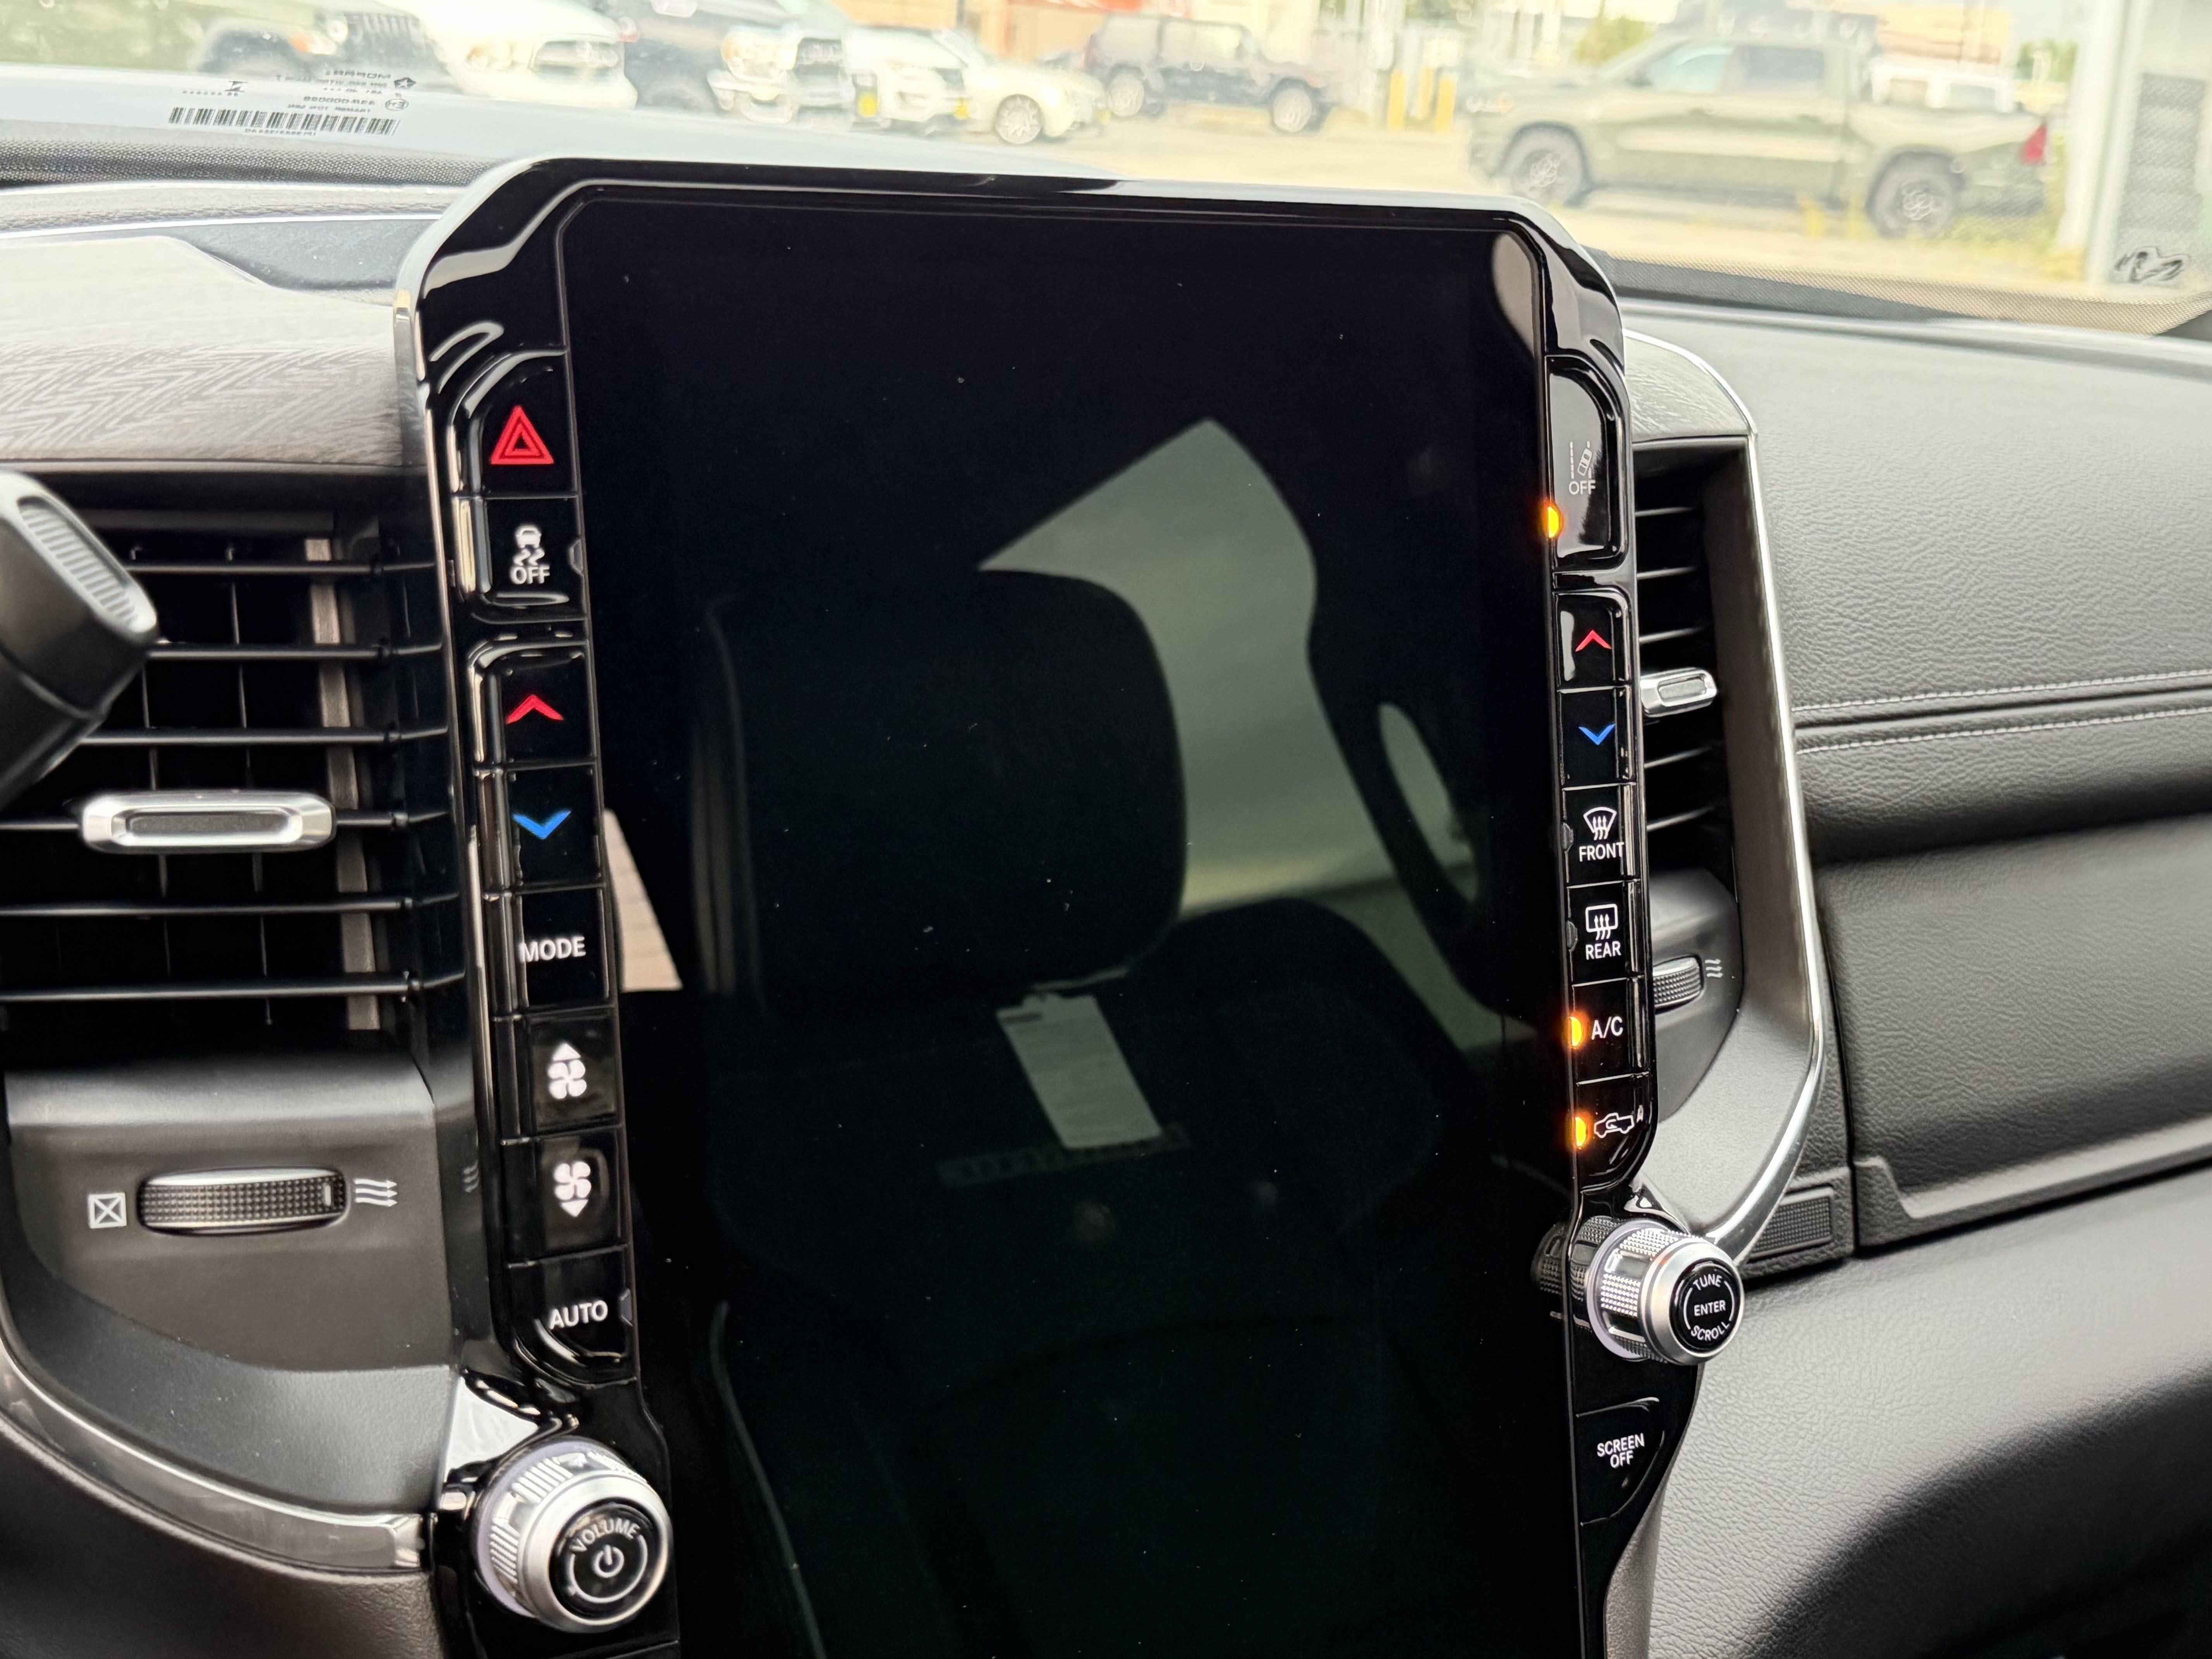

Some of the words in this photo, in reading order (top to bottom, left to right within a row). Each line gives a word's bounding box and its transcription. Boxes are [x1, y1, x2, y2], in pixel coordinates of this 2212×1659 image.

[1569, 480, 1596, 495] OFF
[510, 564, 550, 584] OFF
[1579, 842, 1625, 862] FRONT
[519, 935, 586, 963] MODE
[1585, 941, 1621, 960] REAR
[1591, 1016, 1623, 1040] A/C
[1693, 1274, 1723, 1290] TUNE
[548, 1300, 608, 1329] AUTO
[1694, 1300, 1726, 1316] ENTER
[1690, 1321, 1730, 1341] SCROLL
[1597, 1432, 1645, 1457] SCREEN
[1610, 1450, 1634, 1469] OFF
[569, 1518, 641, 1552] VOLUME
